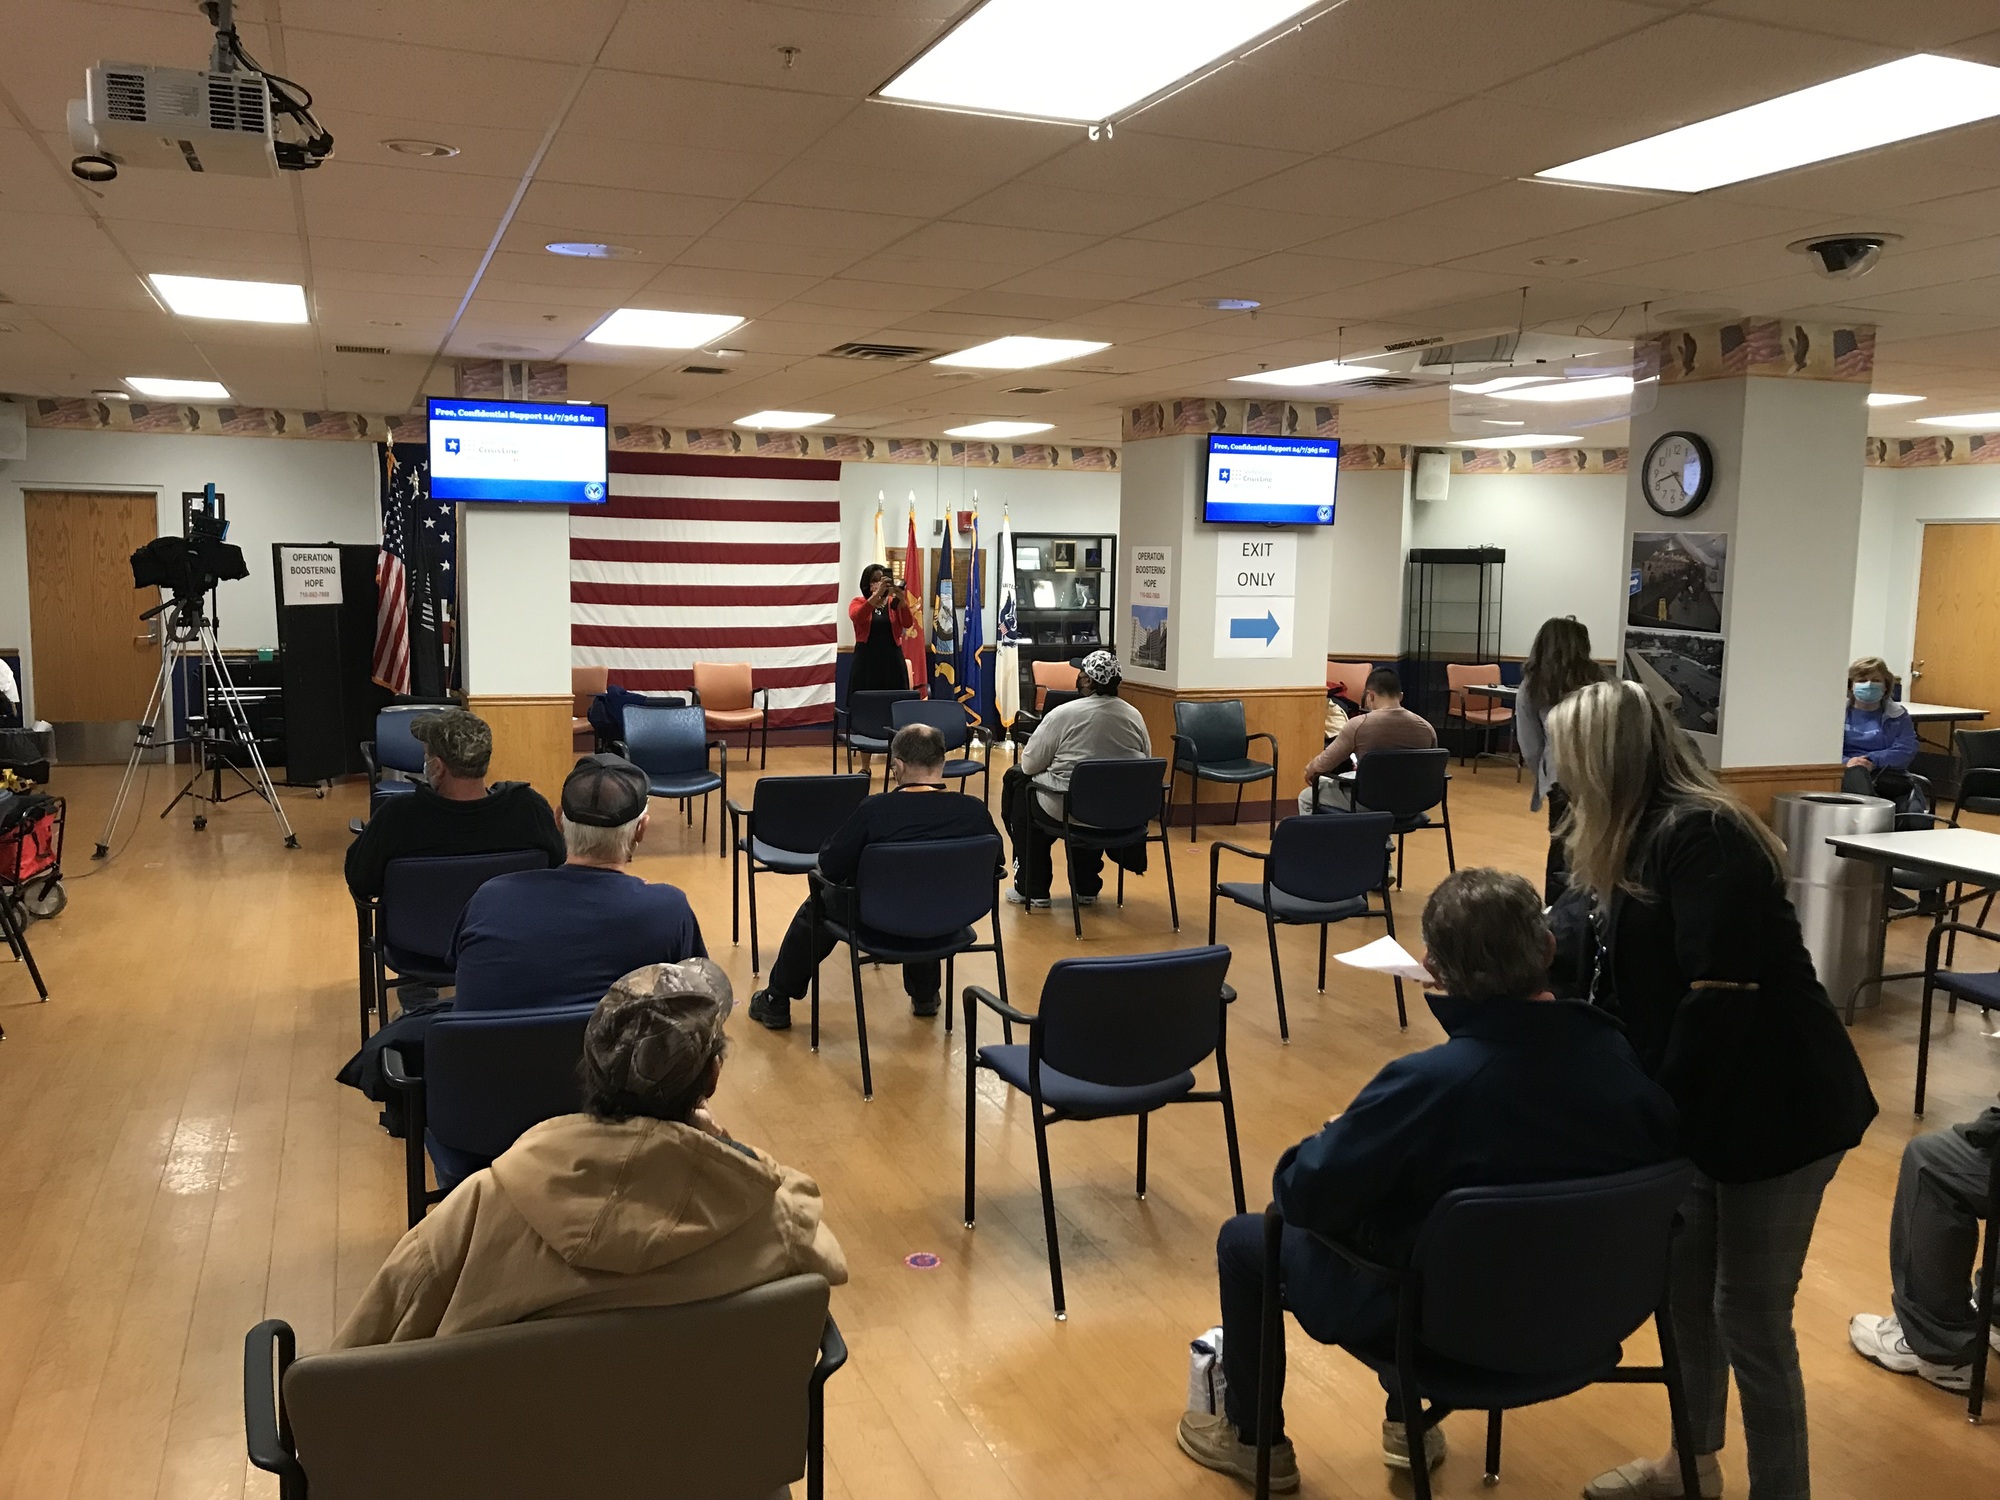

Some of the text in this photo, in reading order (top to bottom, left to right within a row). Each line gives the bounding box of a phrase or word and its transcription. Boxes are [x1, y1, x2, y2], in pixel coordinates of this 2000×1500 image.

[435, 408, 594, 423] Free, Confidential Support 24/7/365 for:
[1214, 442, 1229, 451] Free,
[1230, 443, 1267, 451] Confidential
[1267, 445, 1291, 454] Support
[1292, 446, 1318, 454] 24/7/365
[1242, 542, 1274, 557] EXIT
[292, 553, 333, 562] OPERATION
[1137, 552, 1165, 561] OPERATION
[290, 566, 336, 575] BOOSTERING
[1135, 565, 1166, 575] BOOSTERING
[304, 578, 324, 588] HOPE
[1143, 578, 1157, 588] HOPE
[1237, 572, 1276, 587] ONLY
